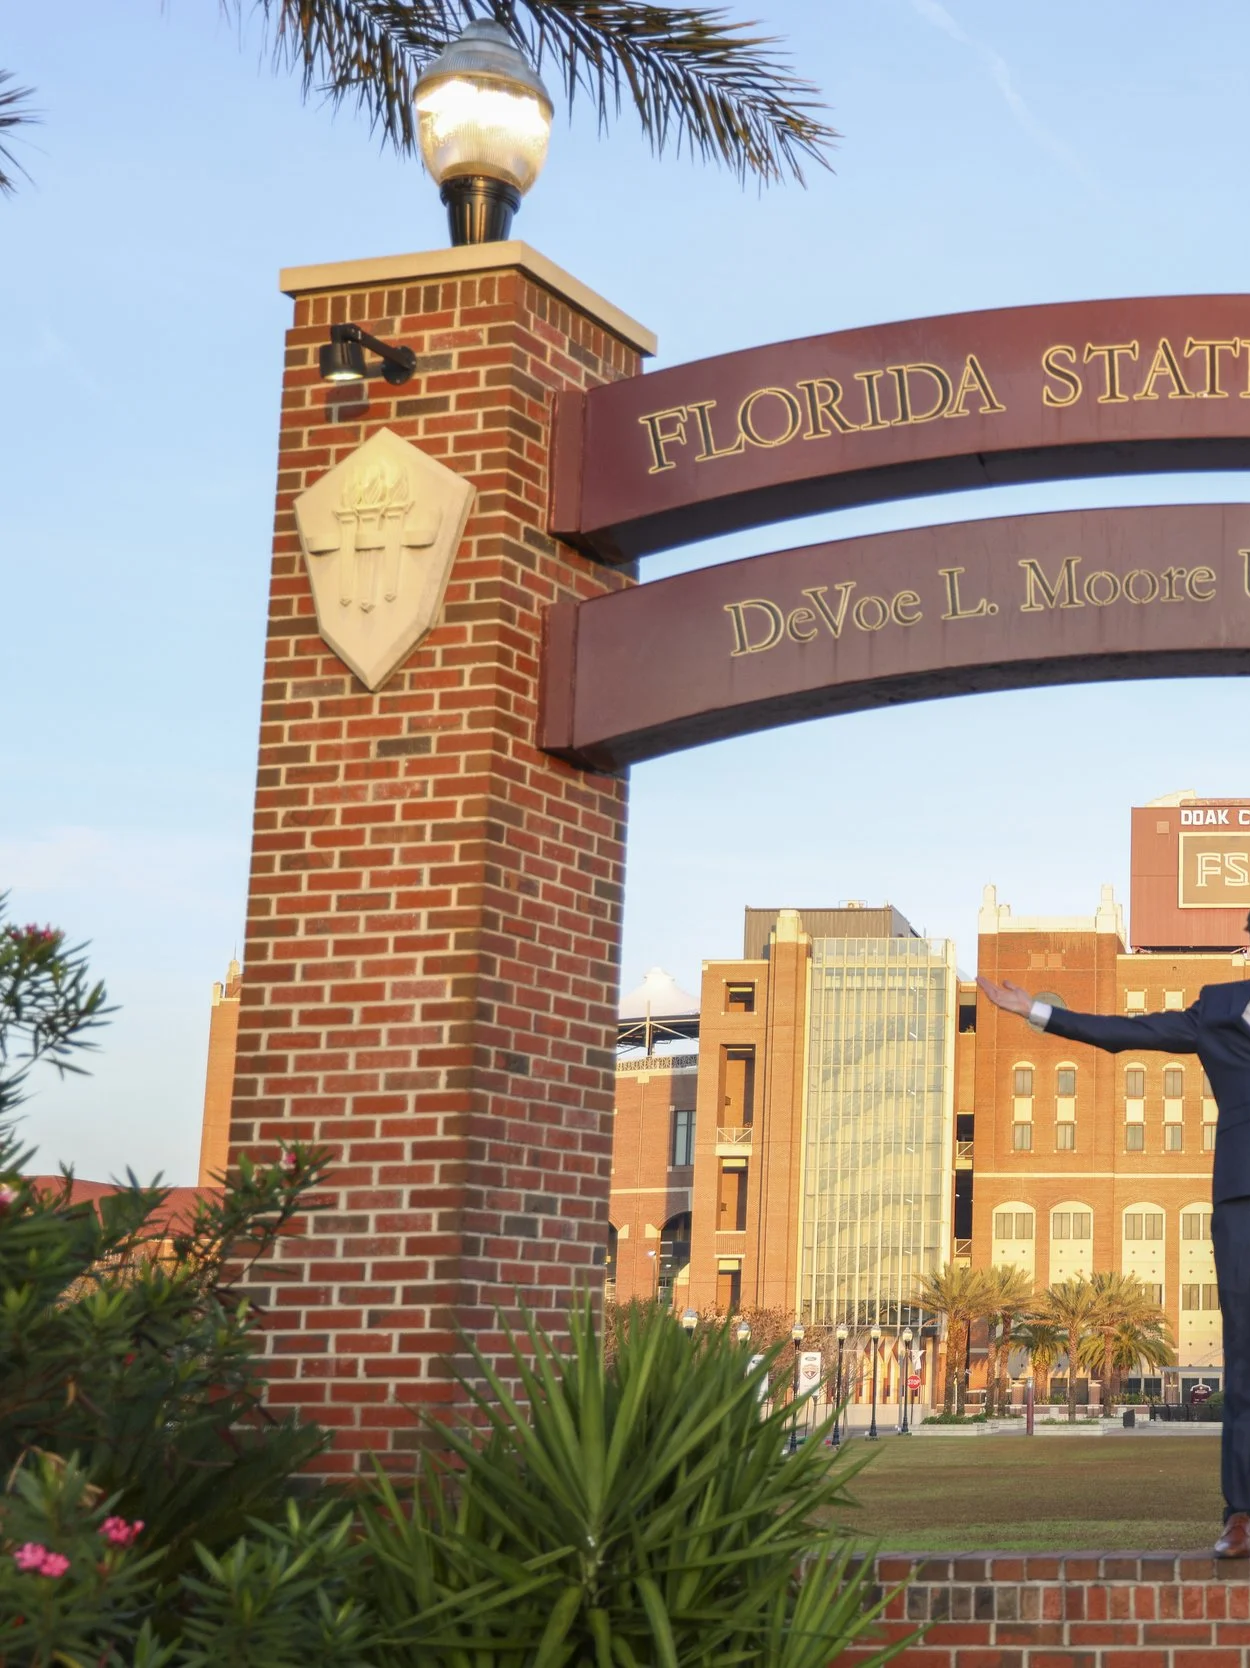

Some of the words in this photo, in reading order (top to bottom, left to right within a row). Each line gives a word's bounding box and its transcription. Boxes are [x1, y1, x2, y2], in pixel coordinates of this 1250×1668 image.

[638, 353, 1006, 474] FLORIDA
[724, 581, 924, 657] DeVoe
[938, 567, 1000, 621] L.
[1018, 556, 1217, 613] Moore
[1180, 808, 1230, 826] DOAK
